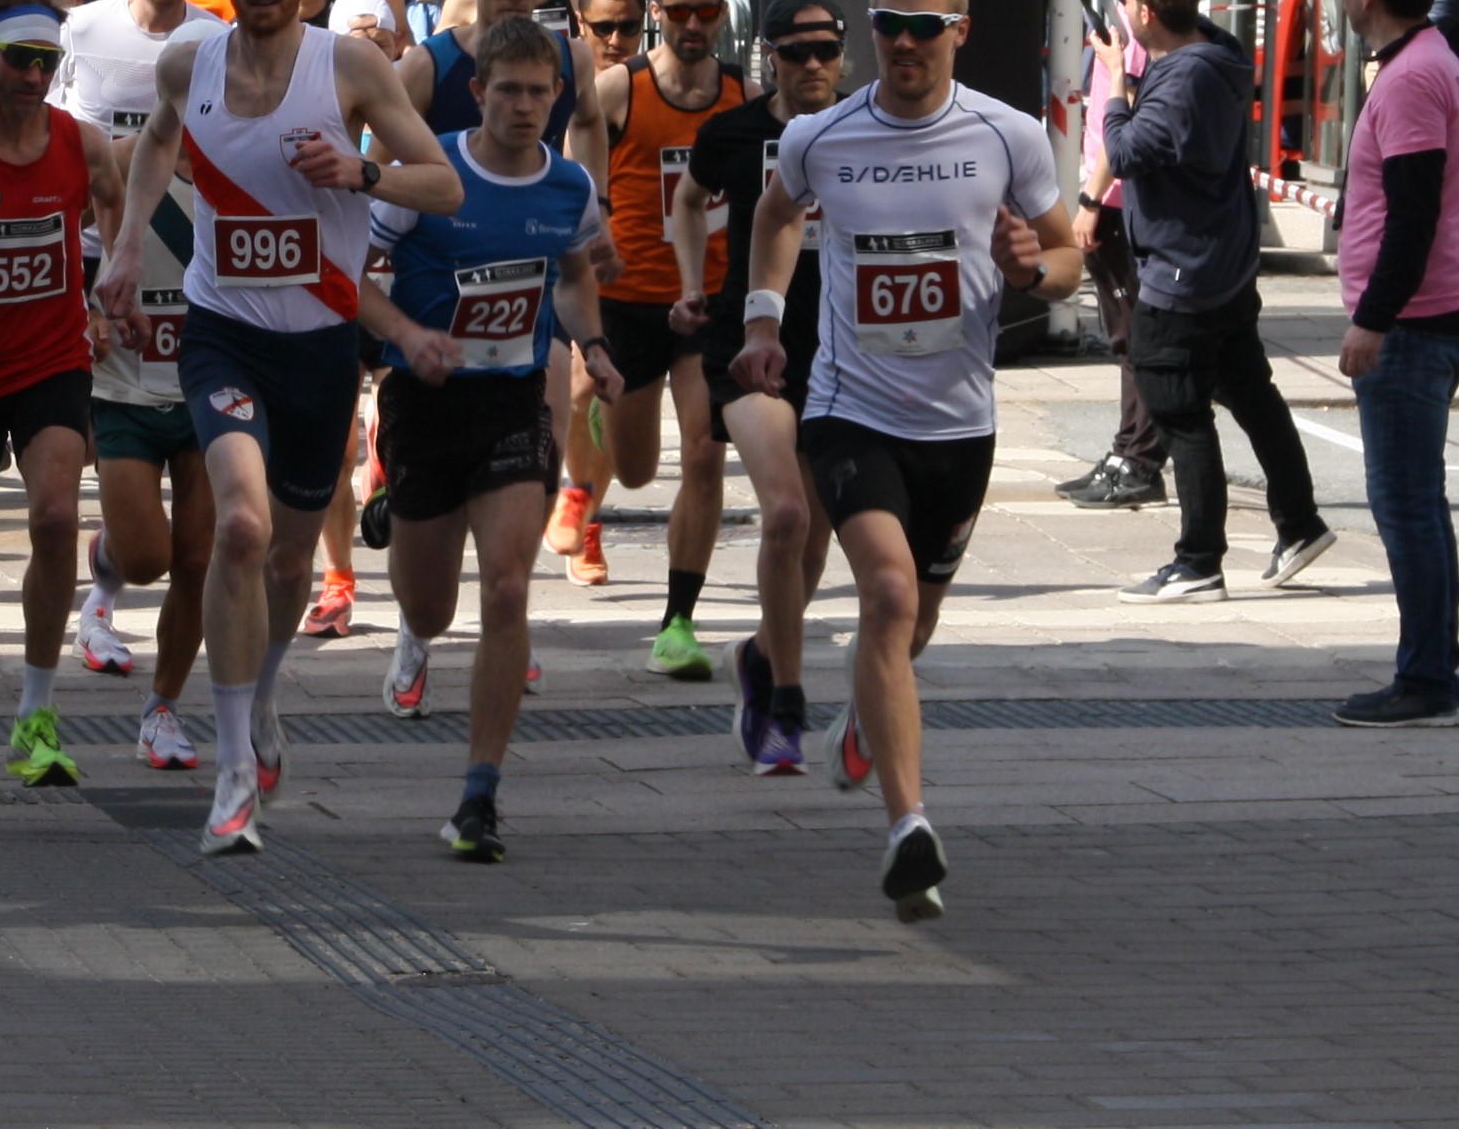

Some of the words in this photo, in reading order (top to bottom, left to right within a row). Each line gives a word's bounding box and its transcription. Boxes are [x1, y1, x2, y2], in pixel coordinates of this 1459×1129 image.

[230, 229, 301, 270] 996
[465, 297, 528, 333] 222
[871, 272, 944, 317] 676
